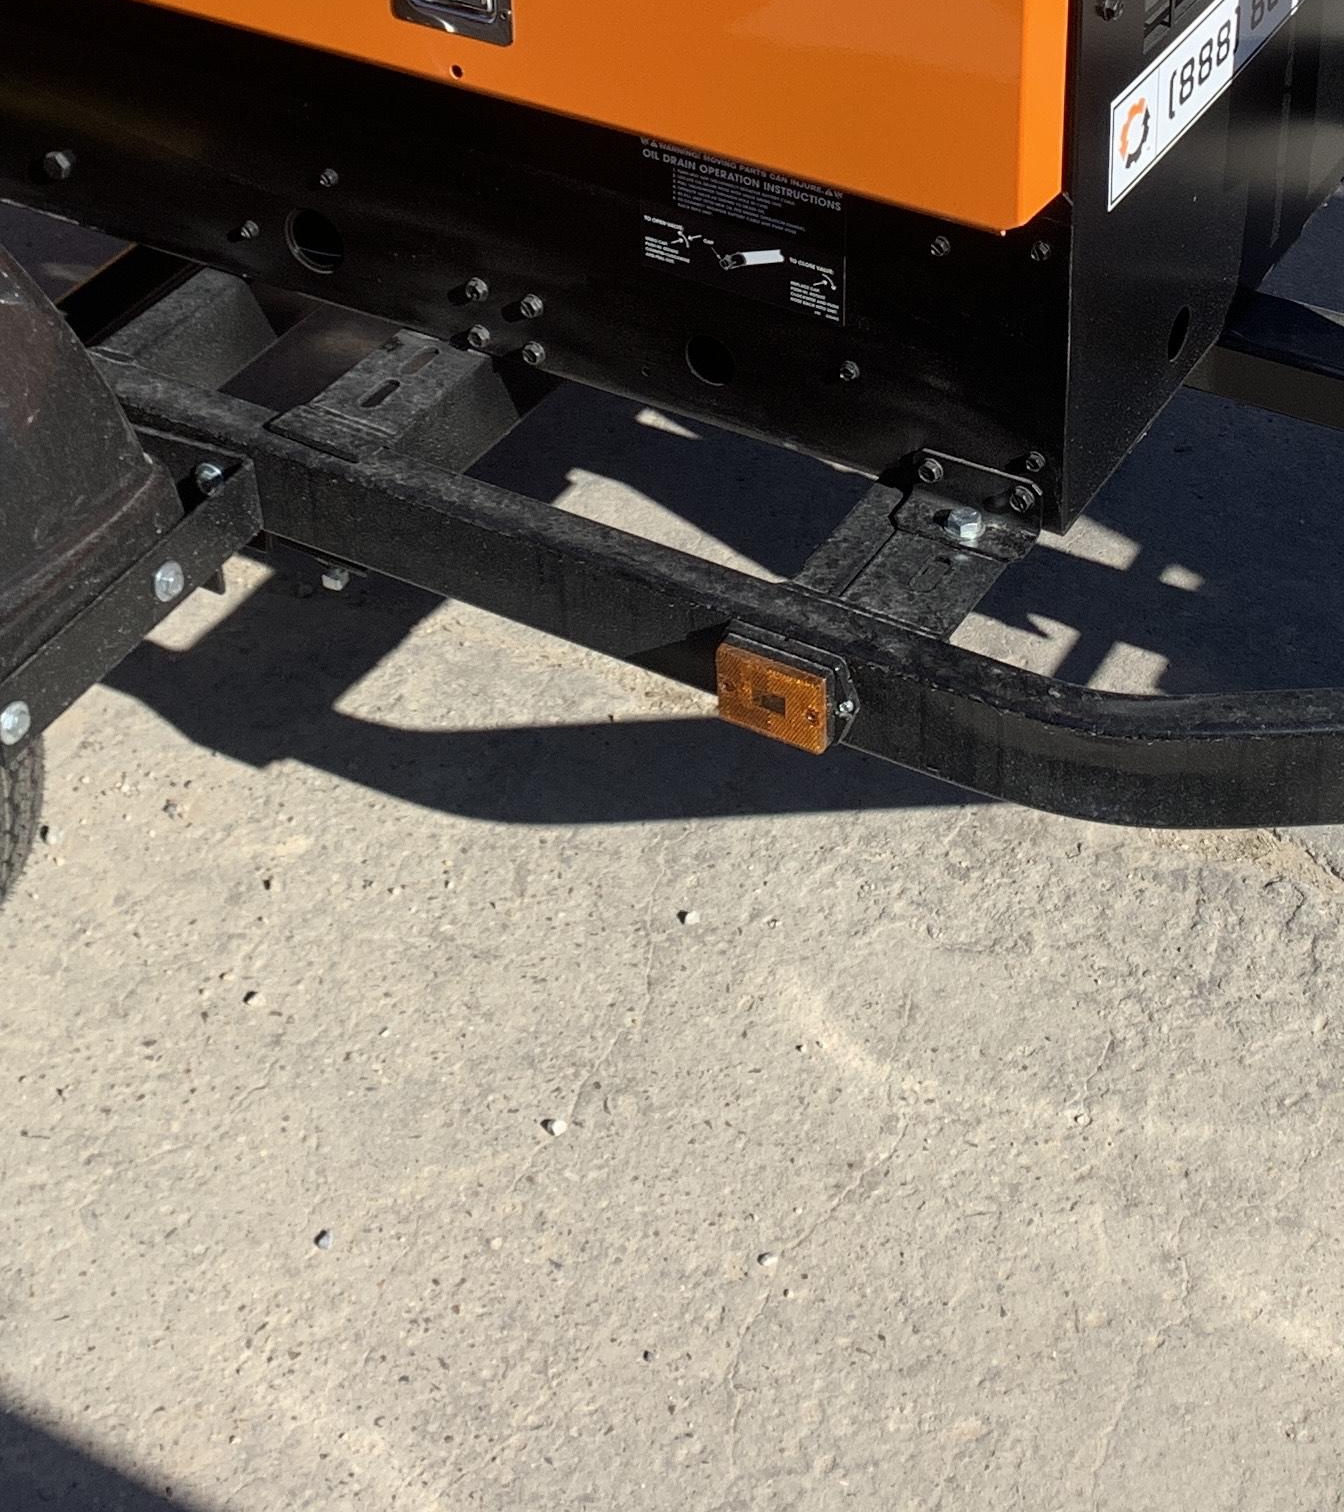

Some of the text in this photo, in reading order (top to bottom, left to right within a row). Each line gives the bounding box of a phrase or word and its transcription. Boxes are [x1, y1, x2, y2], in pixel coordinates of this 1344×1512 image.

[642, 147, 842, 212] OIL DRAIN OPERATION INSTRUCTIONS
